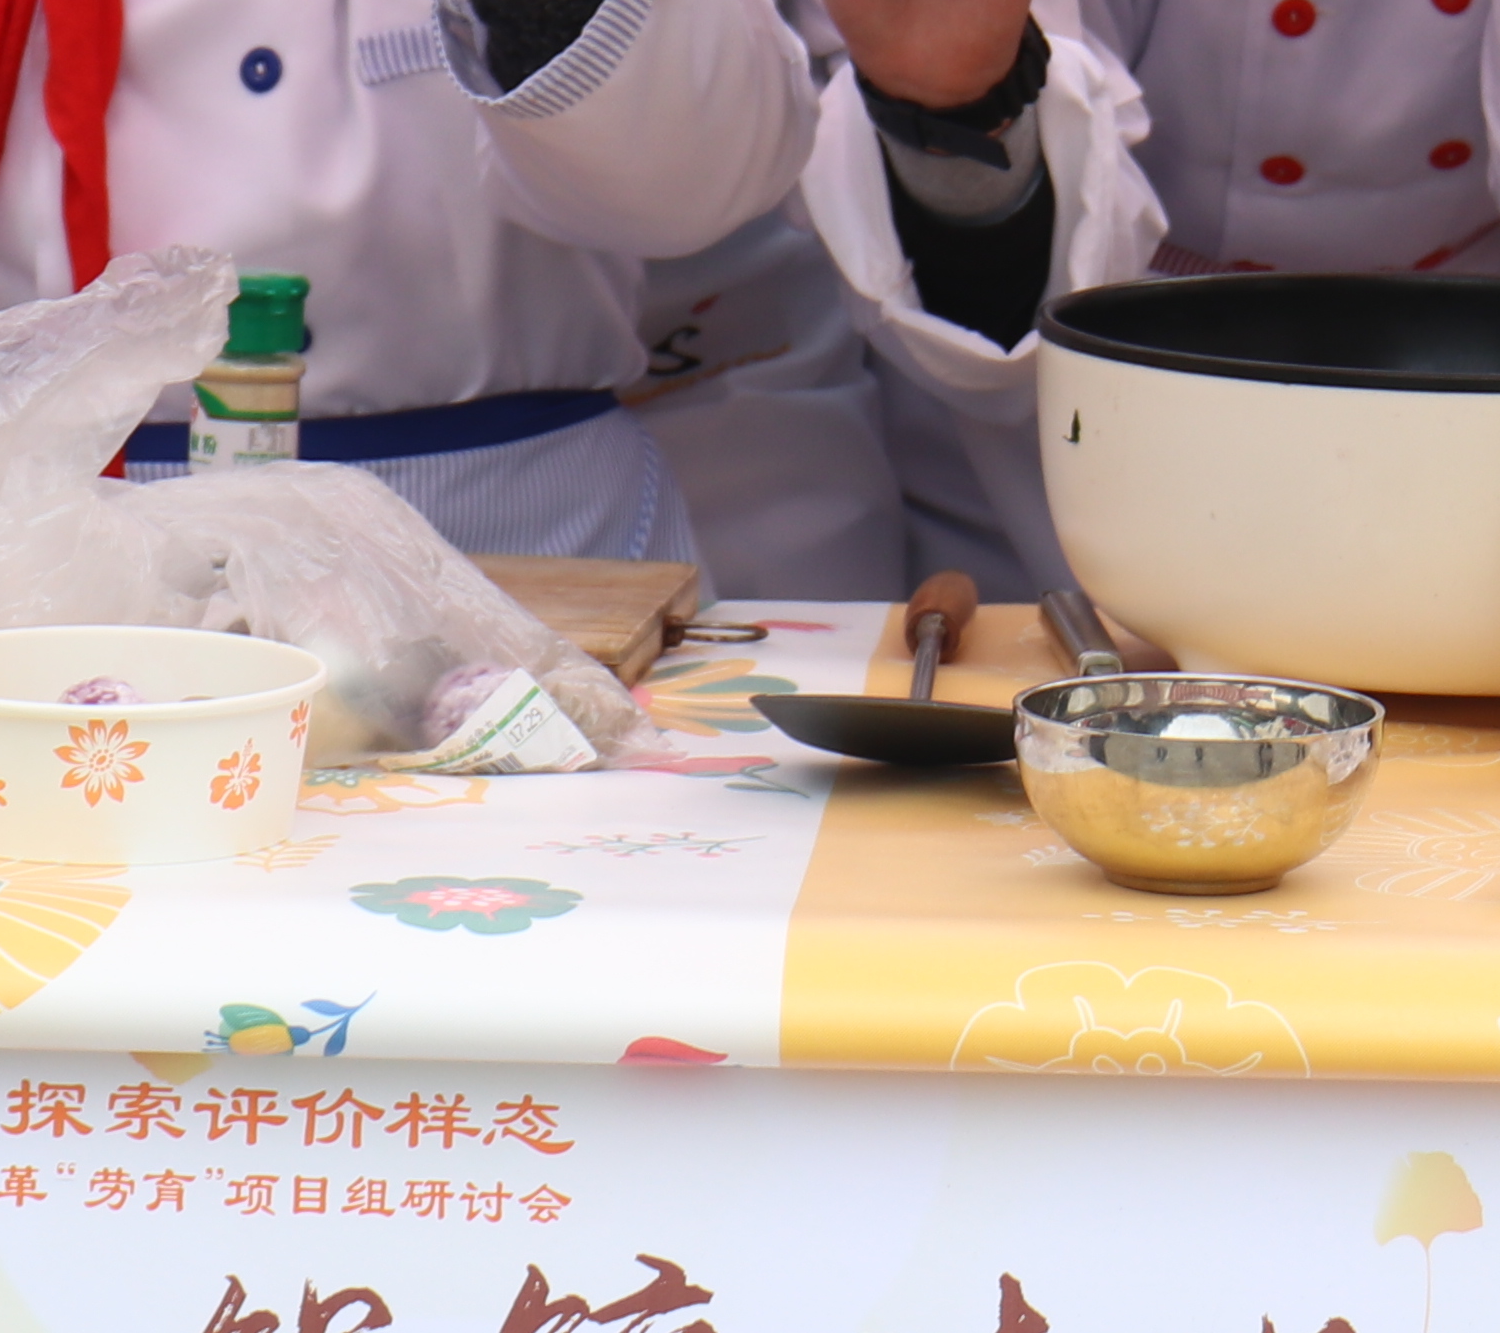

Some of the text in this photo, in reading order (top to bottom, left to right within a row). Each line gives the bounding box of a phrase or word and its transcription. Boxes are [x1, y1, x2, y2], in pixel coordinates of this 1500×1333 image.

[0, 1079, 576, 1155] 探索评价样态
